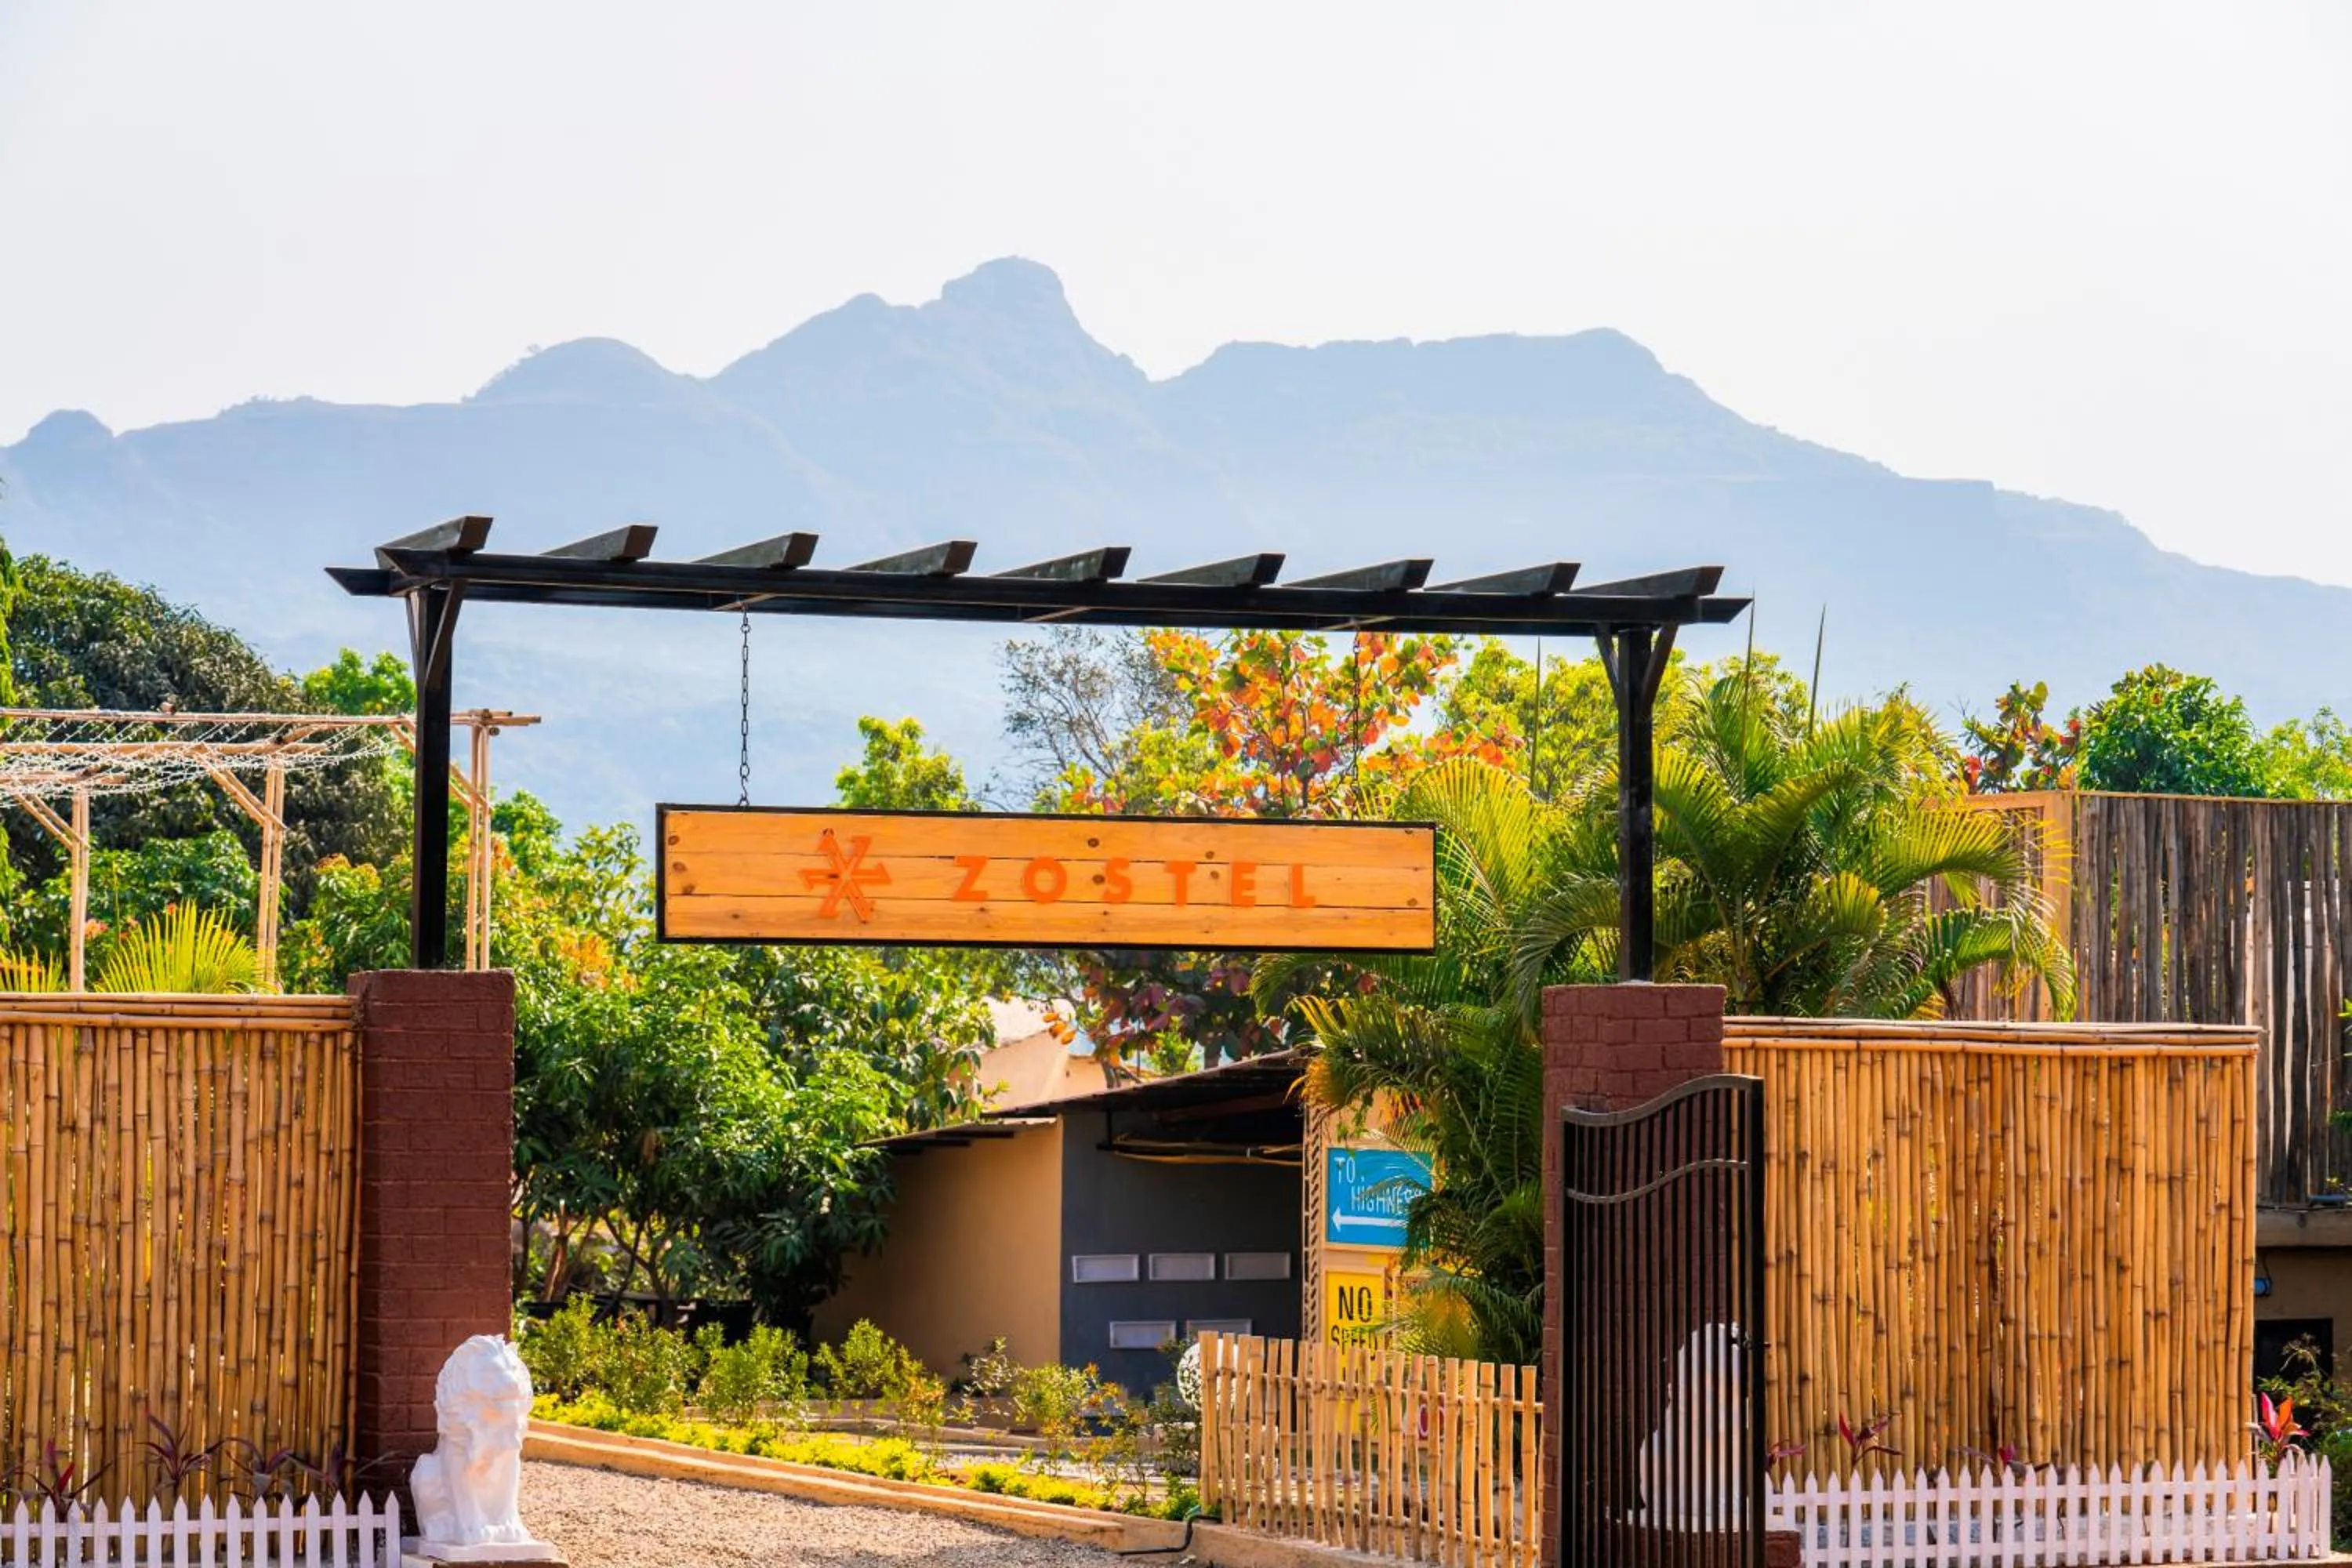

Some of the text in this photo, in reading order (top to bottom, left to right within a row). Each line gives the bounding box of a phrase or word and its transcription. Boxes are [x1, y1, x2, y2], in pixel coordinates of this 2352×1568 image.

[951, 855, 1317, 908] ZOSTEL
[1334, 1156, 1356, 1184] TO
[1339, 1286, 1372, 1323] NO
